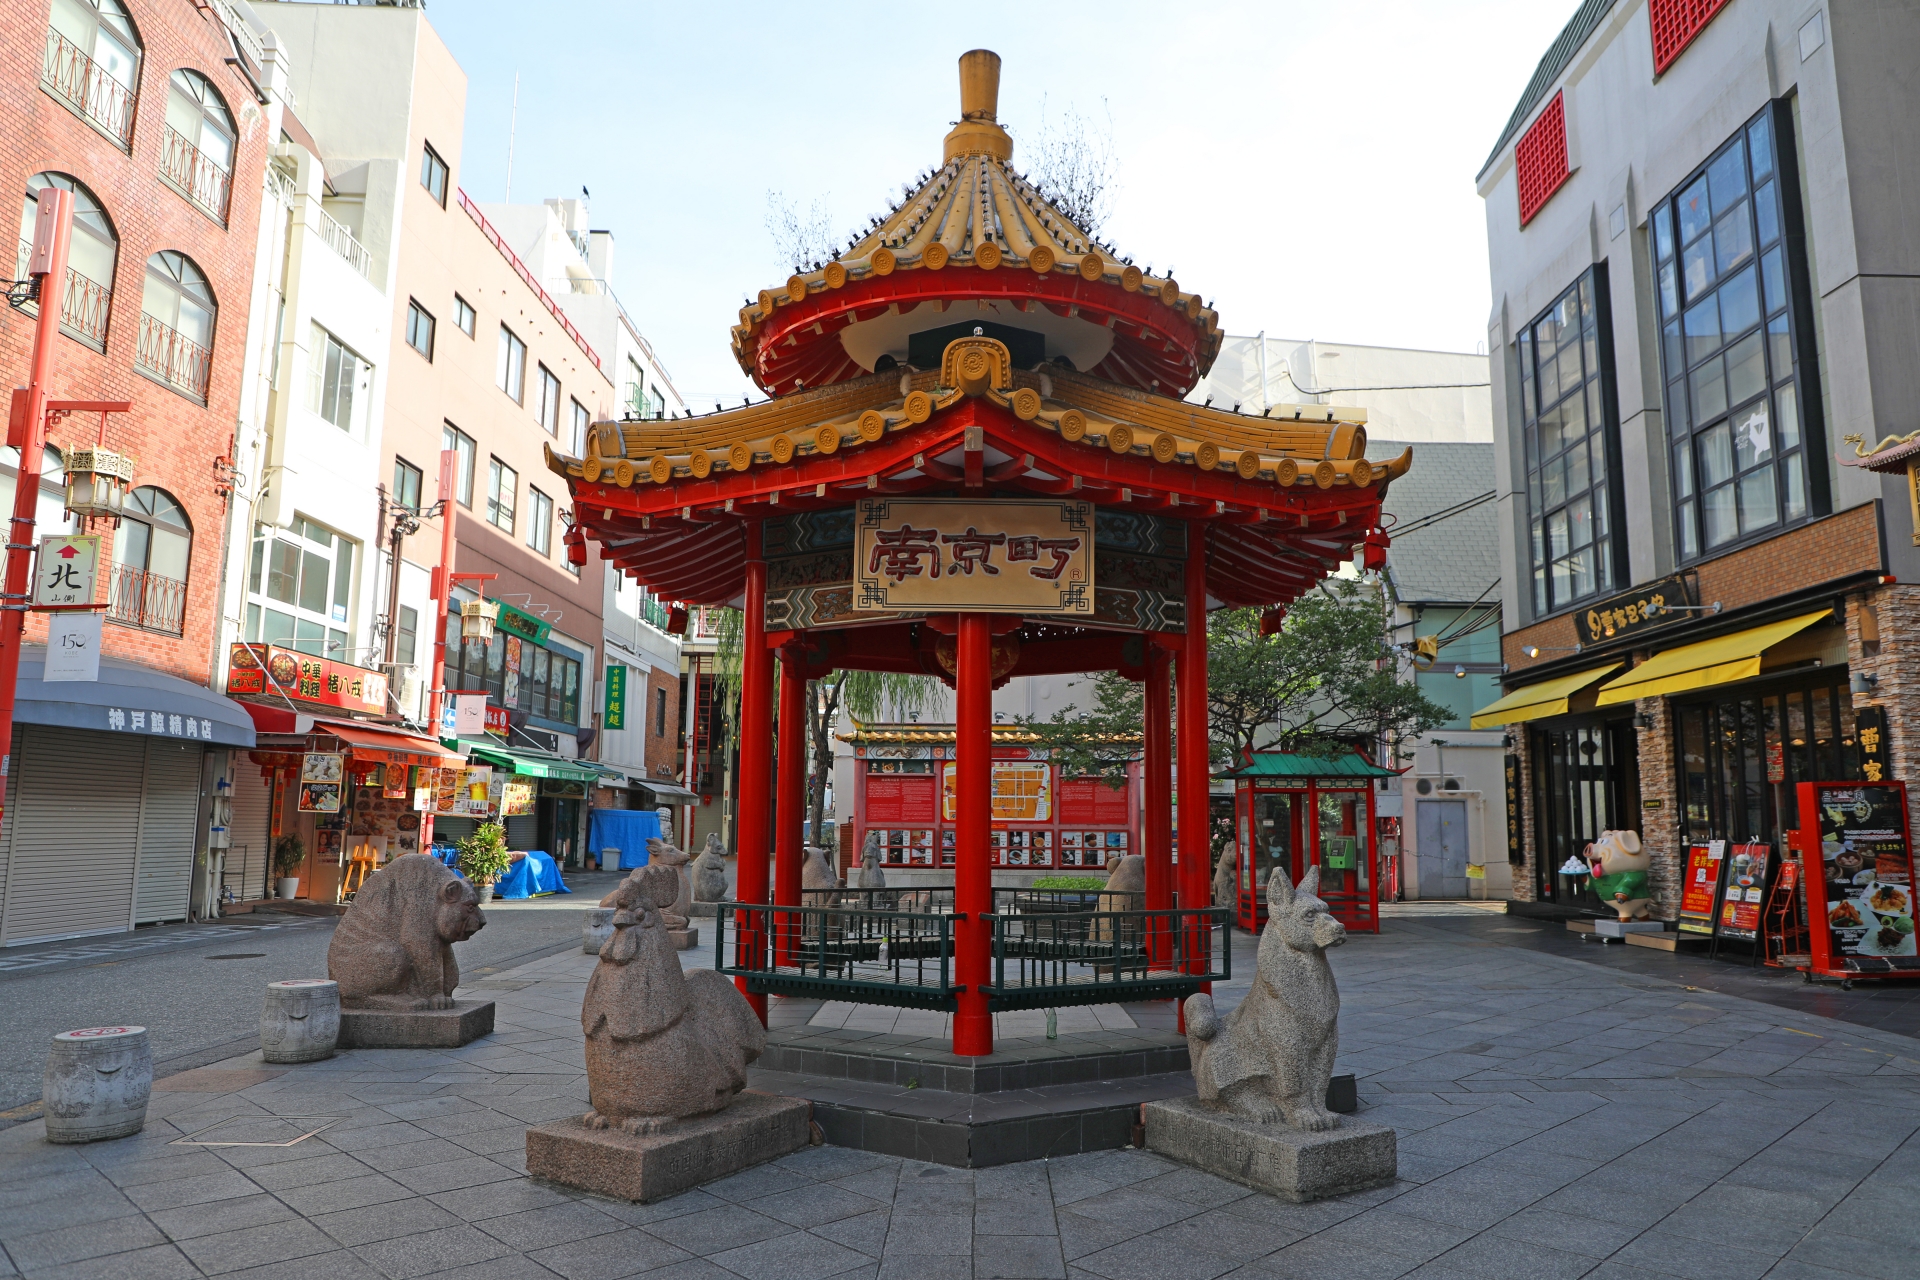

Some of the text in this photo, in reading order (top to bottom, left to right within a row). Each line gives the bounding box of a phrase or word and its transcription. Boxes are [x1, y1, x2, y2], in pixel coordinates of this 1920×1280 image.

[869, 524, 1081, 582] 南京町
[48, 563, 82, 588] 北
[51, 594, 75, 603] 山側
[62, 634, 86, 649] 150
[301, 660, 322, 679] 中華
[300, 679, 321, 698] 料理
[328, 673, 362, 698] 猪八戒
